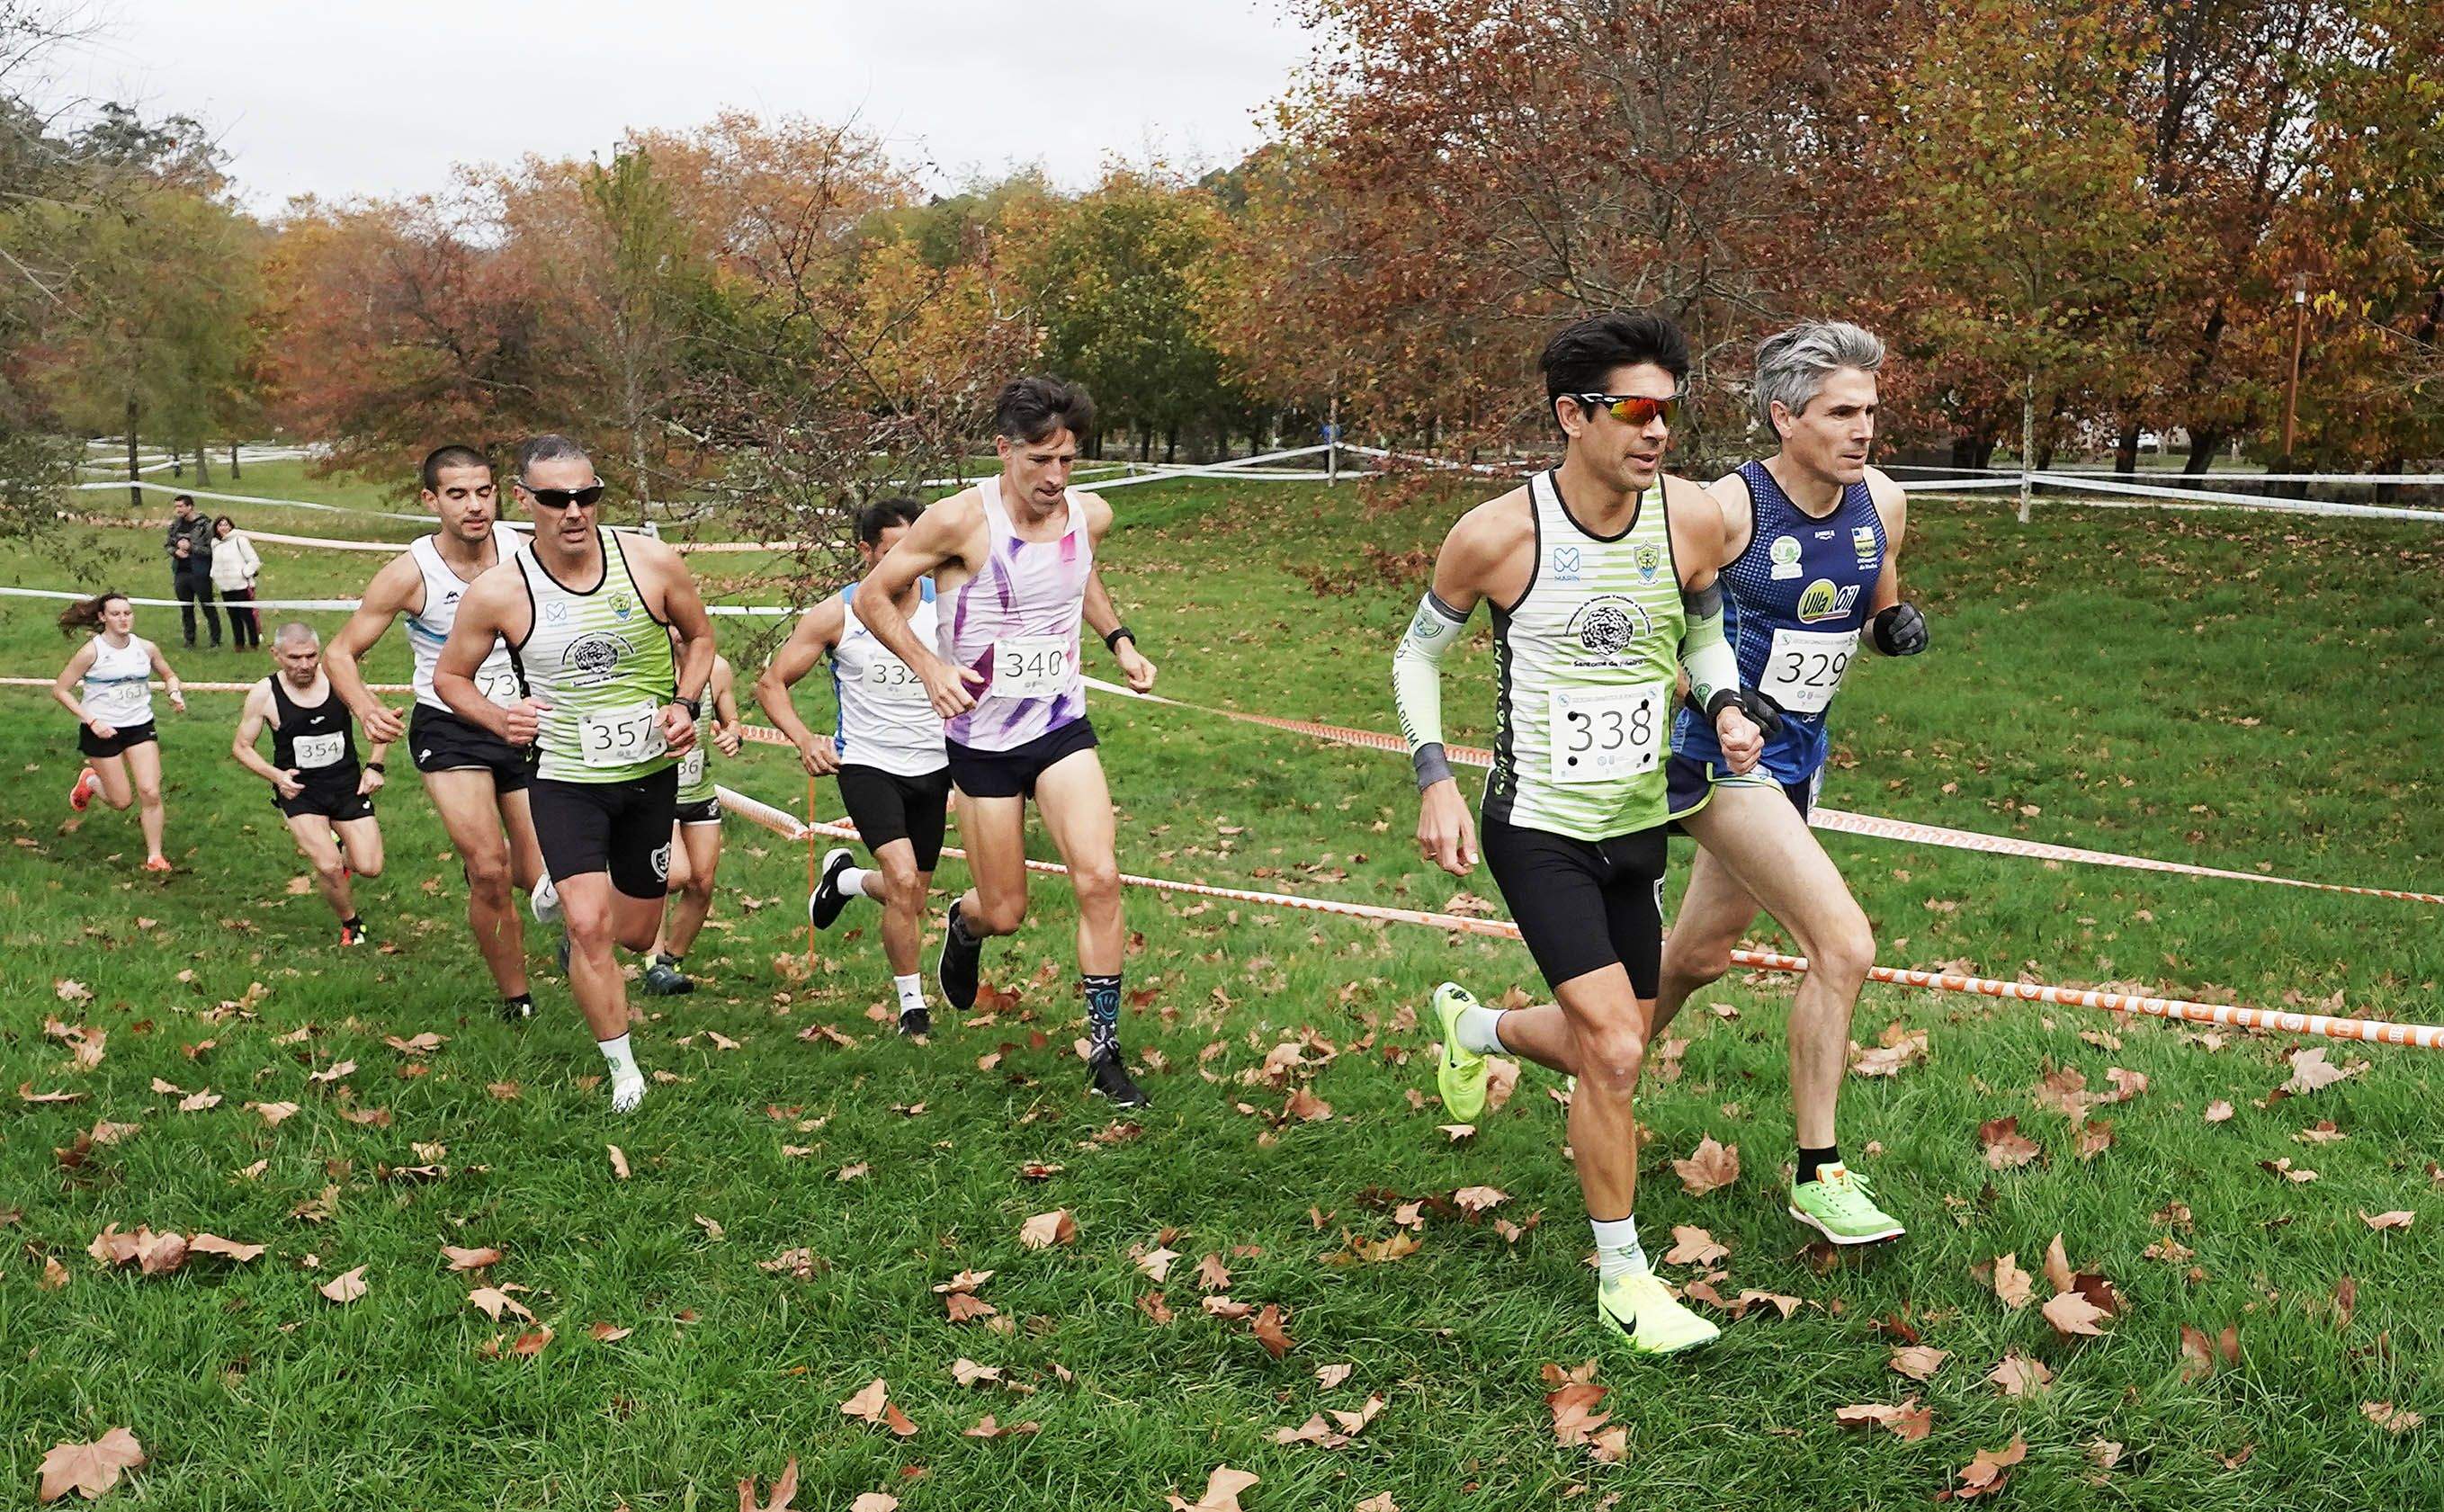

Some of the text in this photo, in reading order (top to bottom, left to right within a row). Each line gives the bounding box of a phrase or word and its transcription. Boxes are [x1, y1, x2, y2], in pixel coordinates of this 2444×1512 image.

[1803, 592, 1829, 615] Ulla
[1005, 650, 1062, 677] 340
[1777, 652, 1848, 686] 329
[480, 675, 515, 697] 73
[592, 714, 653, 749] 357
[1568, 707, 1651, 751] 338
[301, 741, 339, 758] 354
[678, 759, 699, 774] 36
